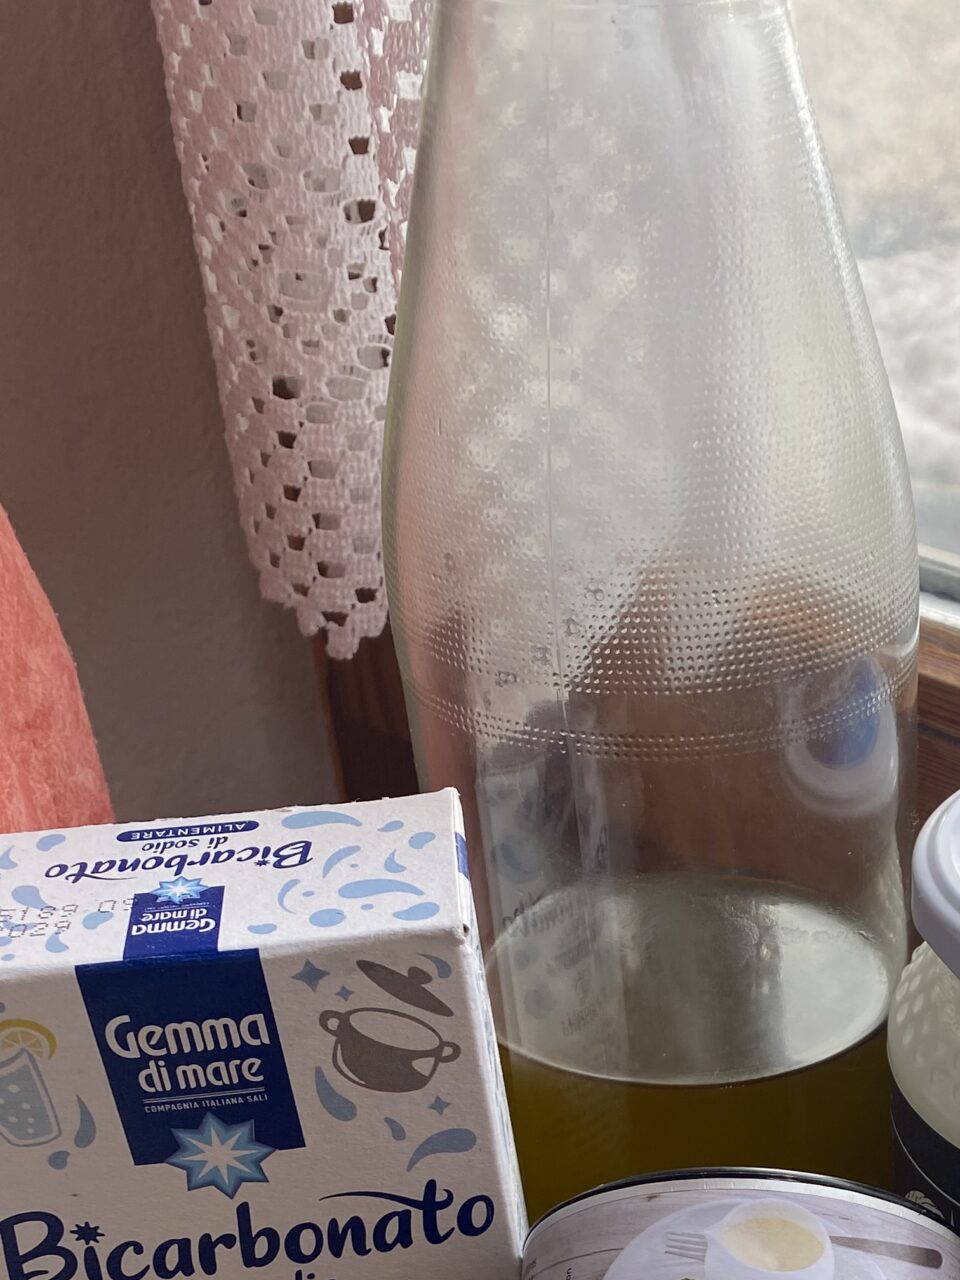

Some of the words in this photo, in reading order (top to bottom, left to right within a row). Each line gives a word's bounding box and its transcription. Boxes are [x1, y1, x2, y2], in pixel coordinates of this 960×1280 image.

[130, 822, 246, 842] ALIMENTARE
[141, 839, 200, 854] sodio
[207, 836, 229, 848] di
[45, 840, 314, 883] Bicarbonato
[140, 910, 188, 922] mare
[188, 909, 208, 922] di
[131, 918, 217, 936] Gemma
[104, 1012, 271, 1061] Gemma
[137, 1059, 172, 1094] di
[177, 1056, 266, 1090] mare
[144, 1101, 200, 1114] COMPAGNIA
[202, 1096, 245, 1109] ITALIANA
[246, 1093, 269, 1103] SALI
